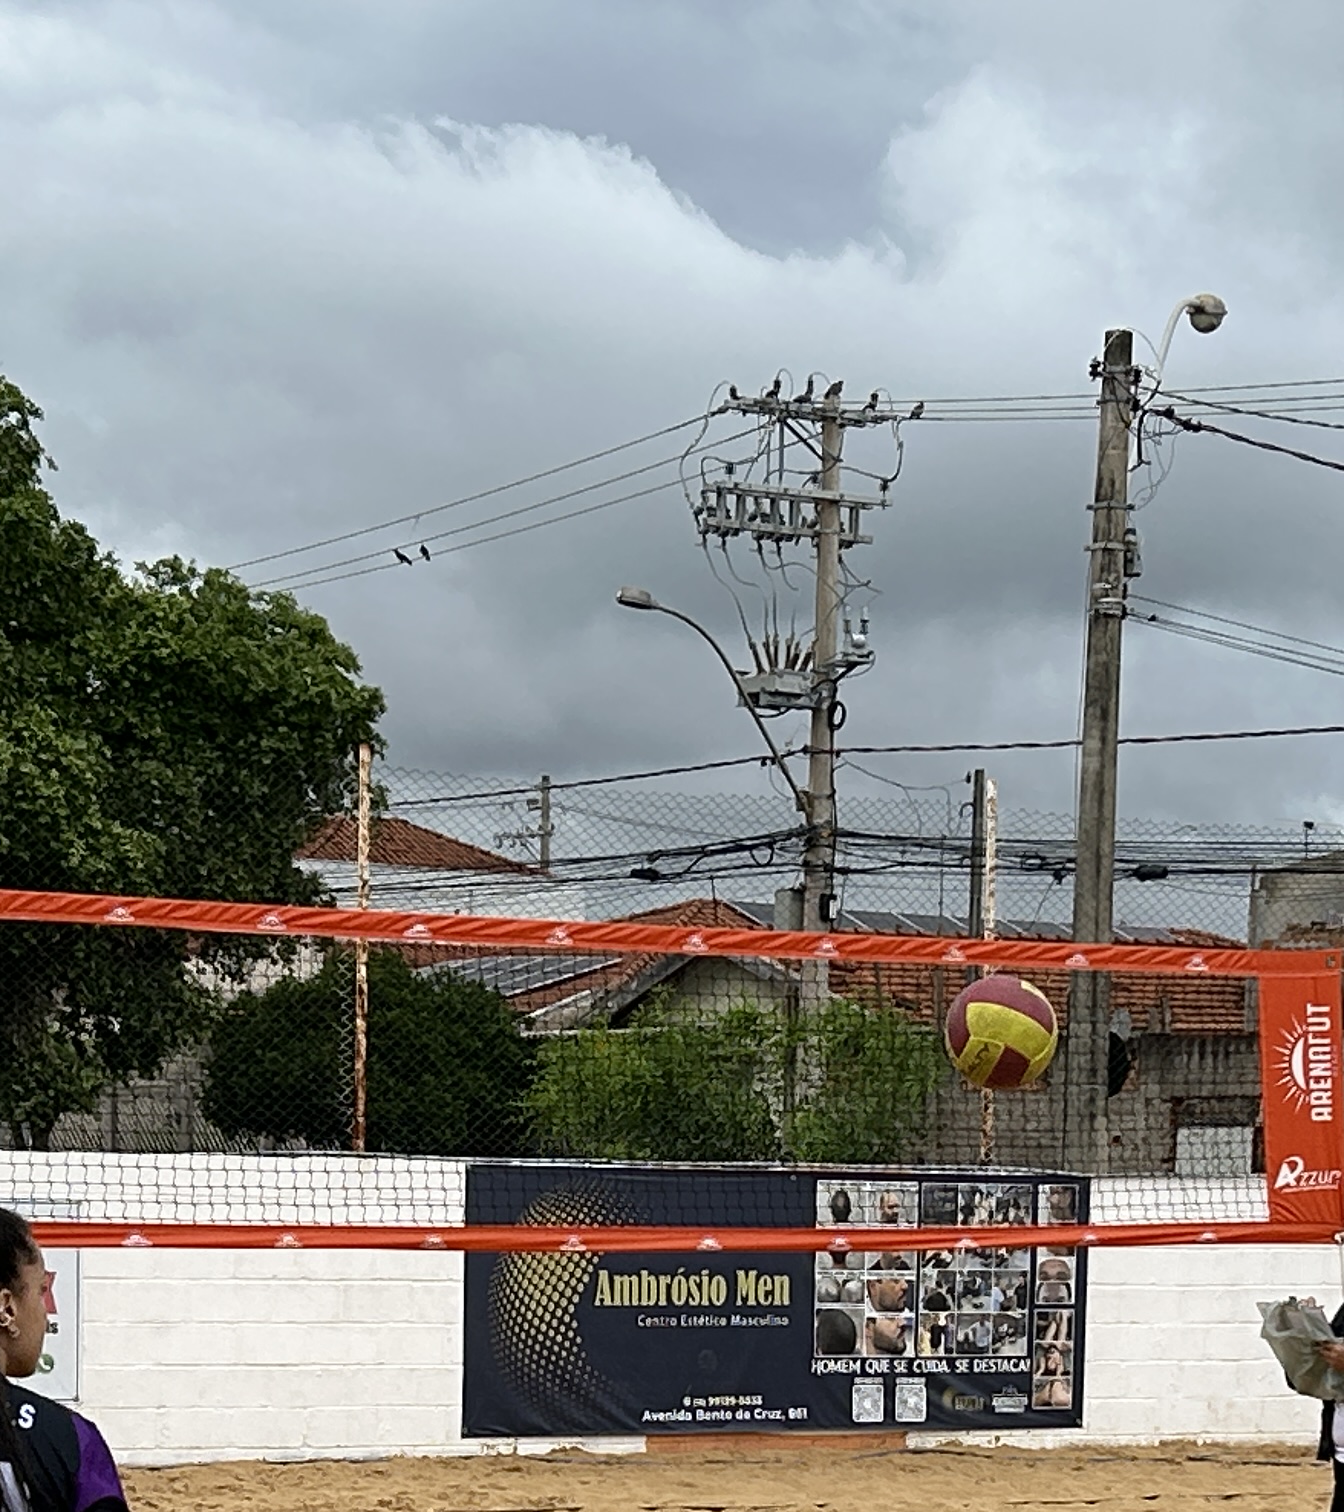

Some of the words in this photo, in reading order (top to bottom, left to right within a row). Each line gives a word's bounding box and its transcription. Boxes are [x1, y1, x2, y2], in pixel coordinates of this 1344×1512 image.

[593, 1267, 728, 1307] Ambrósio
[735, 1269, 791, 1307] Men
[637, 1314, 678, 1327] Centro
[680, 1313, 727, 1327] Estético
[730, 1313, 790, 1327] Masculino
[810, 1358, 861, 1375] HOMEM
[864, 1358, 891, 1374] QUE
[893, 1358, 909, 1374] SE
[954, 1358, 971, 1374] SE
[641, 1408, 693, 1422] Avenida
[696, 1408, 733, 1421] Bento
[753, 1407, 787, 1422] Cruz,
